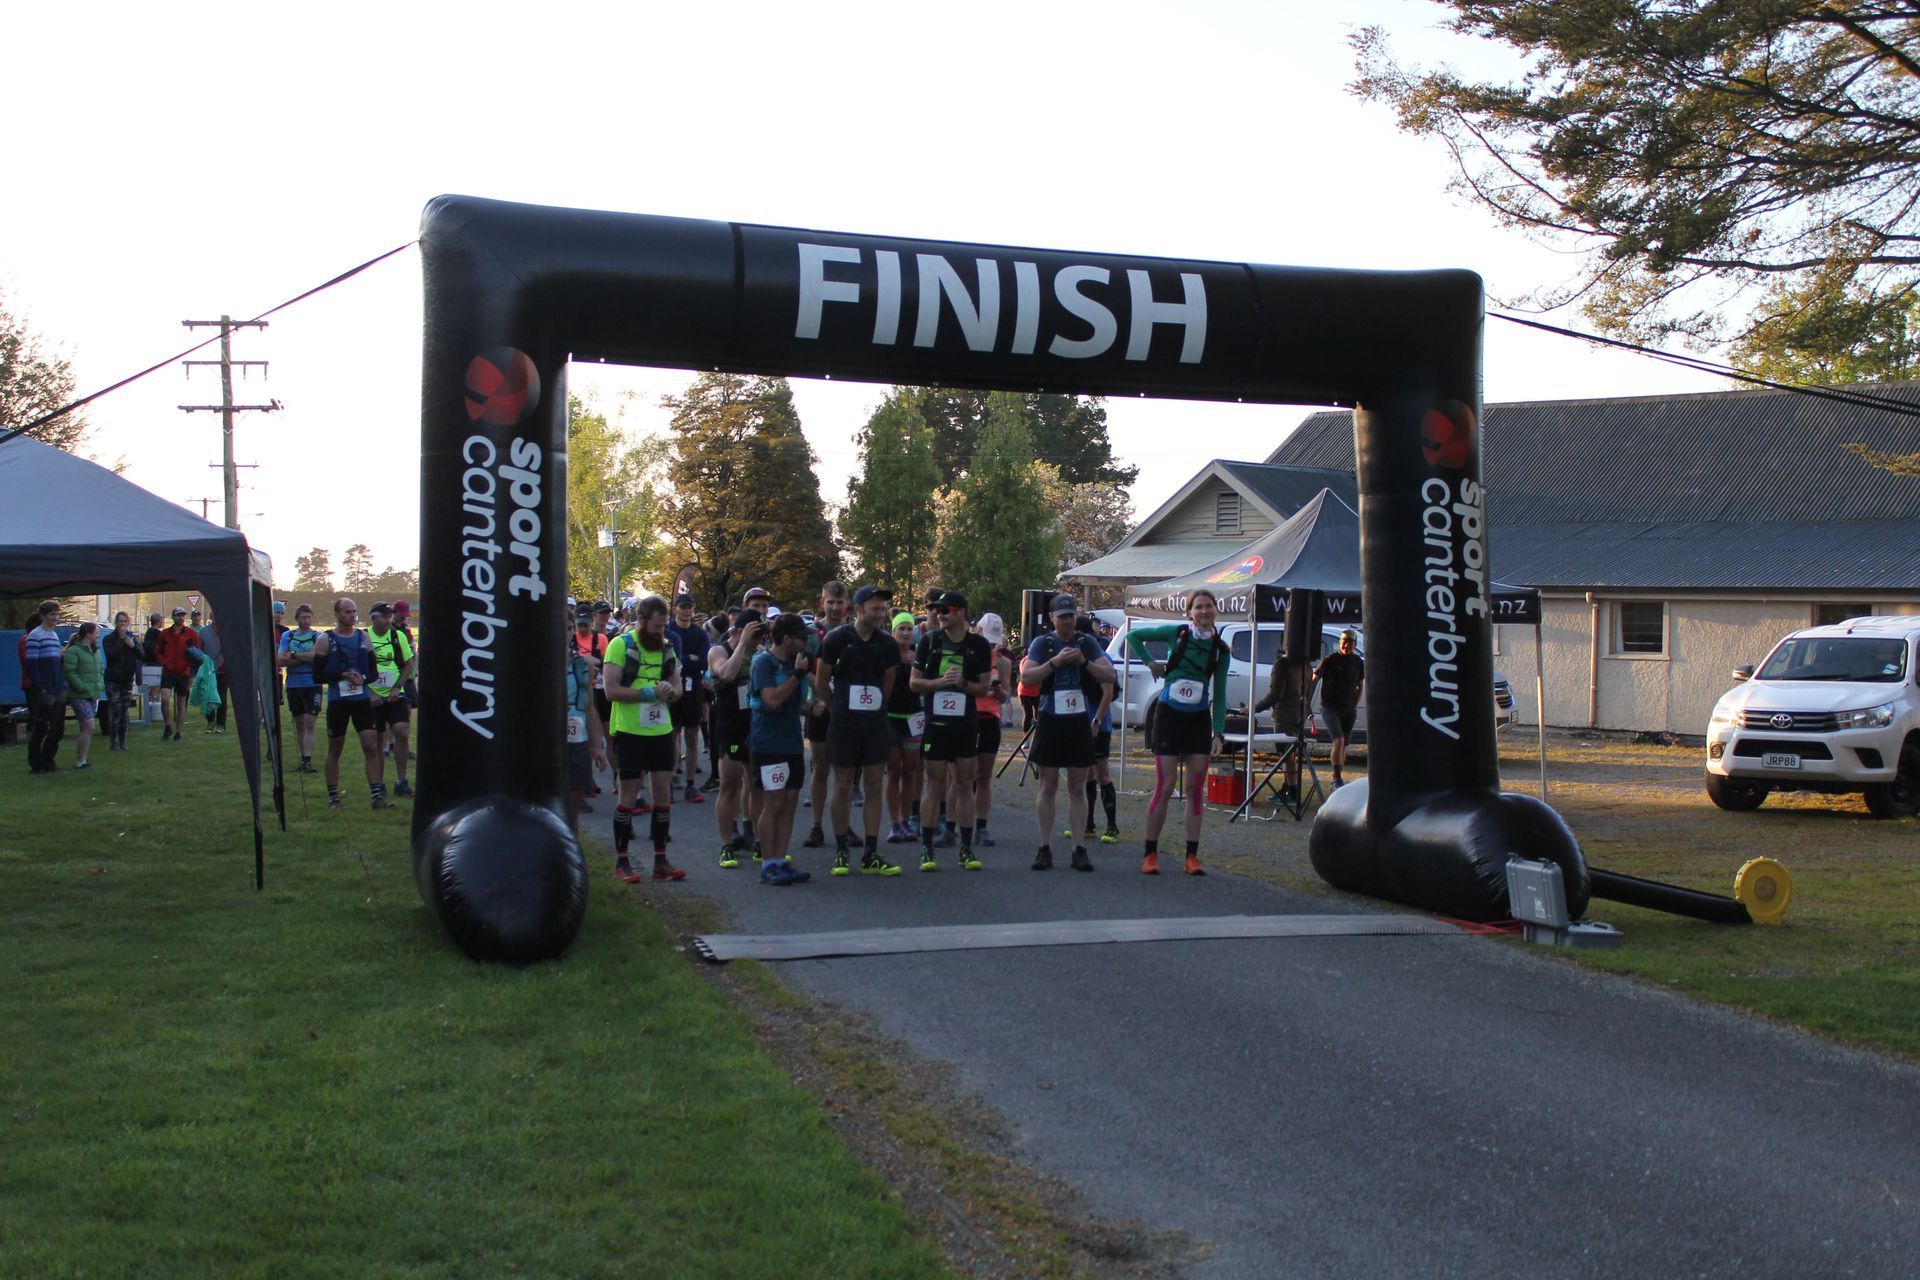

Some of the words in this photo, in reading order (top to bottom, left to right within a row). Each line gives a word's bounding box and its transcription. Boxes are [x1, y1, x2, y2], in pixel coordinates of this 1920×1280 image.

[795, 243, 1208, 364] FINISH
[498, 436, 547, 602] sport
[1453, 477, 1488, 618] sport
[450, 434, 508, 740] canterbury
[1420, 477, 1466, 740] canterbury
[1178, 687, 1193, 698] 40
[859, 694, 873, 705] 55
[942, 700, 956, 710] 22
[1065, 698, 1077, 708] 14
[649, 710, 661, 721] 54
[1766, 756, 1796, 767] JRP88
[771, 772, 785, 784] 66
